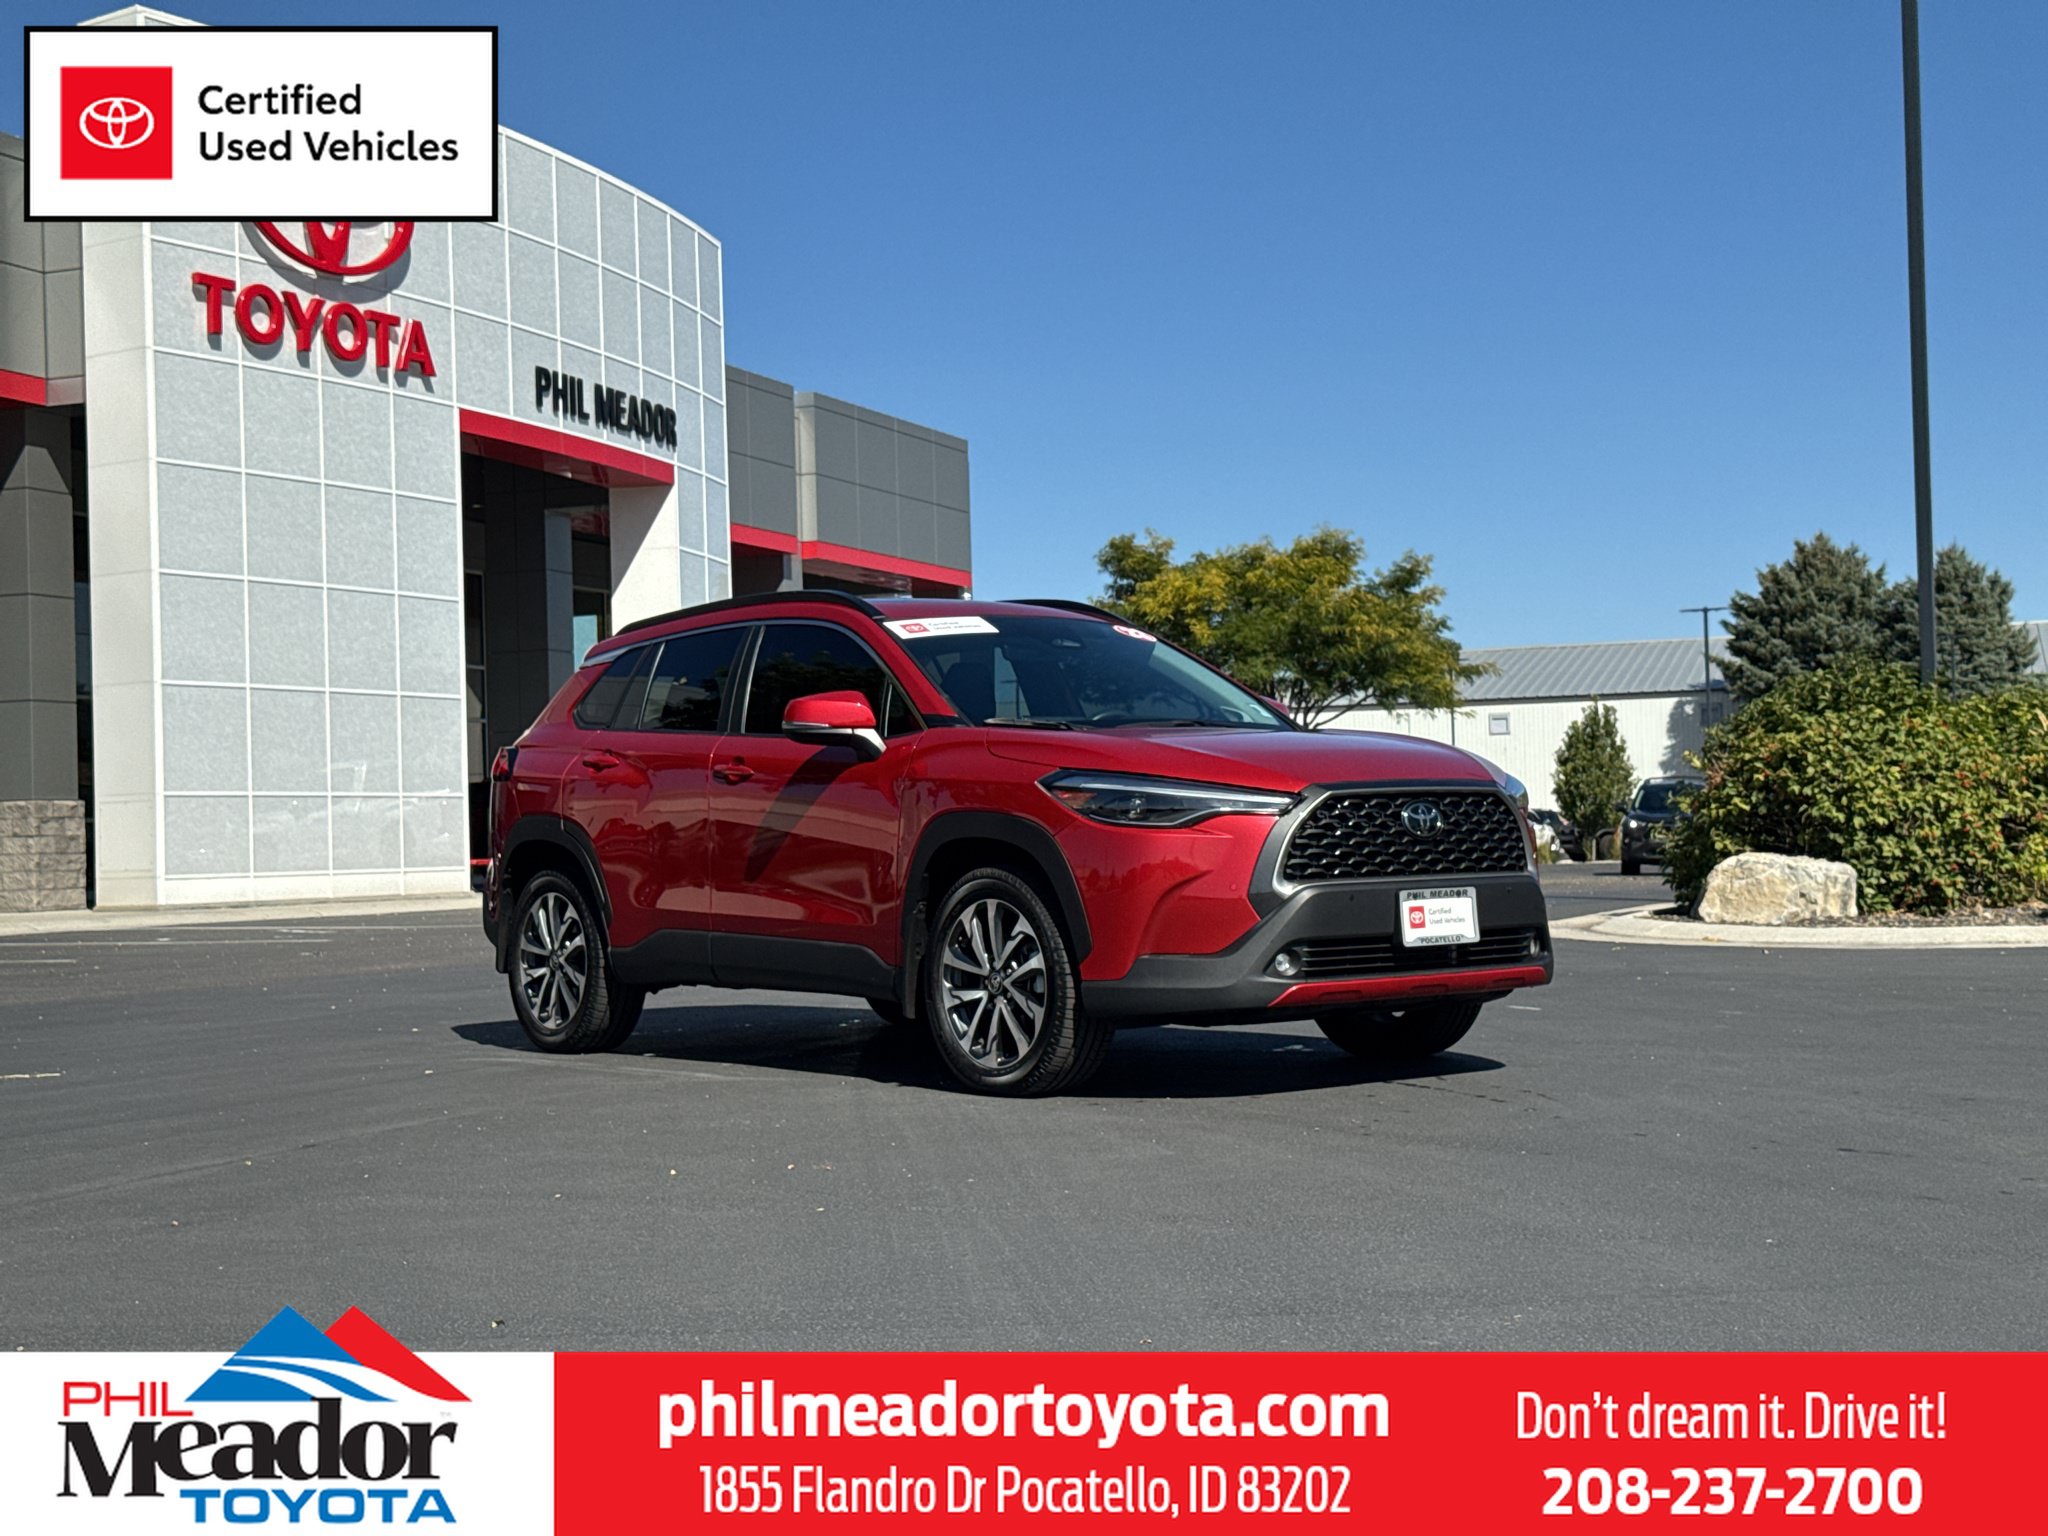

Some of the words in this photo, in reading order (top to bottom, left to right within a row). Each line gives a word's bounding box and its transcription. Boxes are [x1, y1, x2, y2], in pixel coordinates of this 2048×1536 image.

[191, 271, 437, 377] TOYOTA
[535, 365, 590, 422] PHIL
[594, 382, 678, 450] MEADOR
[1428, 907, 1452, 915] Certified
[1429, 889, 1468, 898] MEADOR
